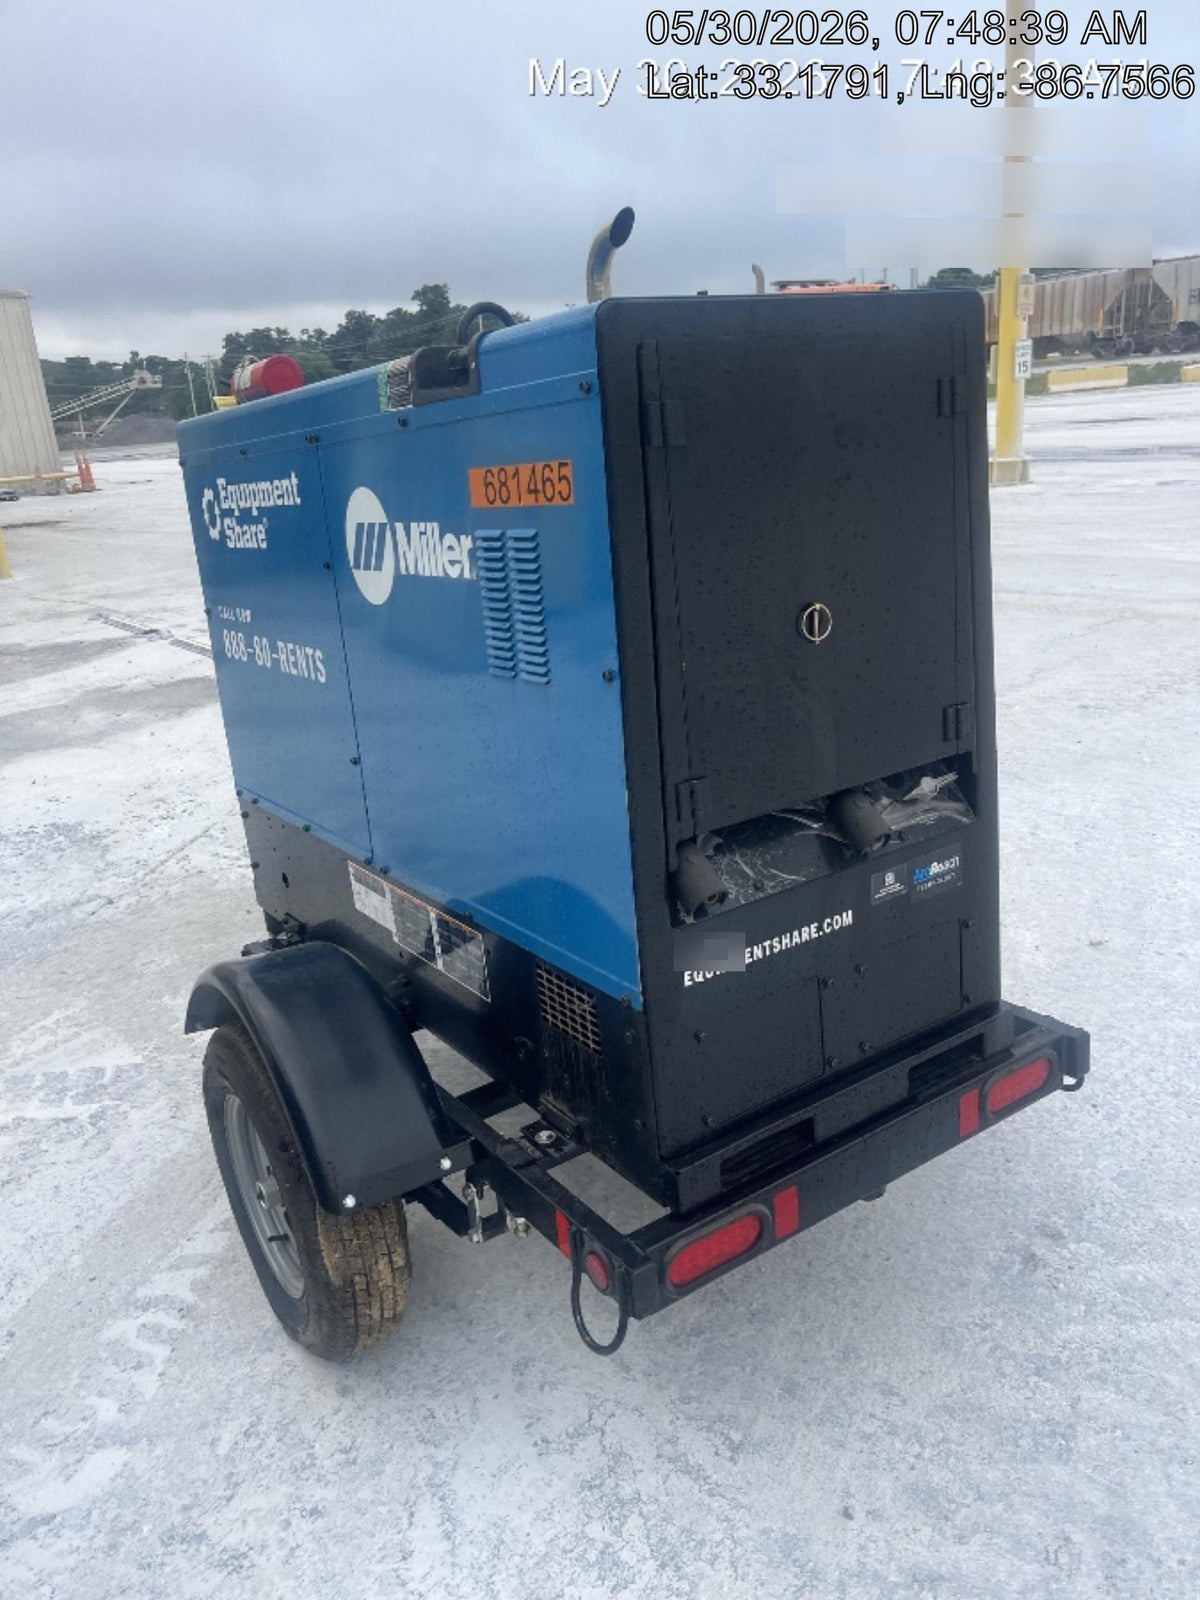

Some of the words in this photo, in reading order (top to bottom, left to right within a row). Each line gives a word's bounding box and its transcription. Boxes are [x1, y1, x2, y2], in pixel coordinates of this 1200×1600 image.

[1018, 360, 1029, 374] 15
[216, 471, 302, 517] Equipment
[483, 461, 573, 506] 681465
[394, 521, 473, 580] Miller
[223, 628, 326, 684] 888-80-RENTS
[683, 910, 854, 988] EQUENTSHARE.COM
